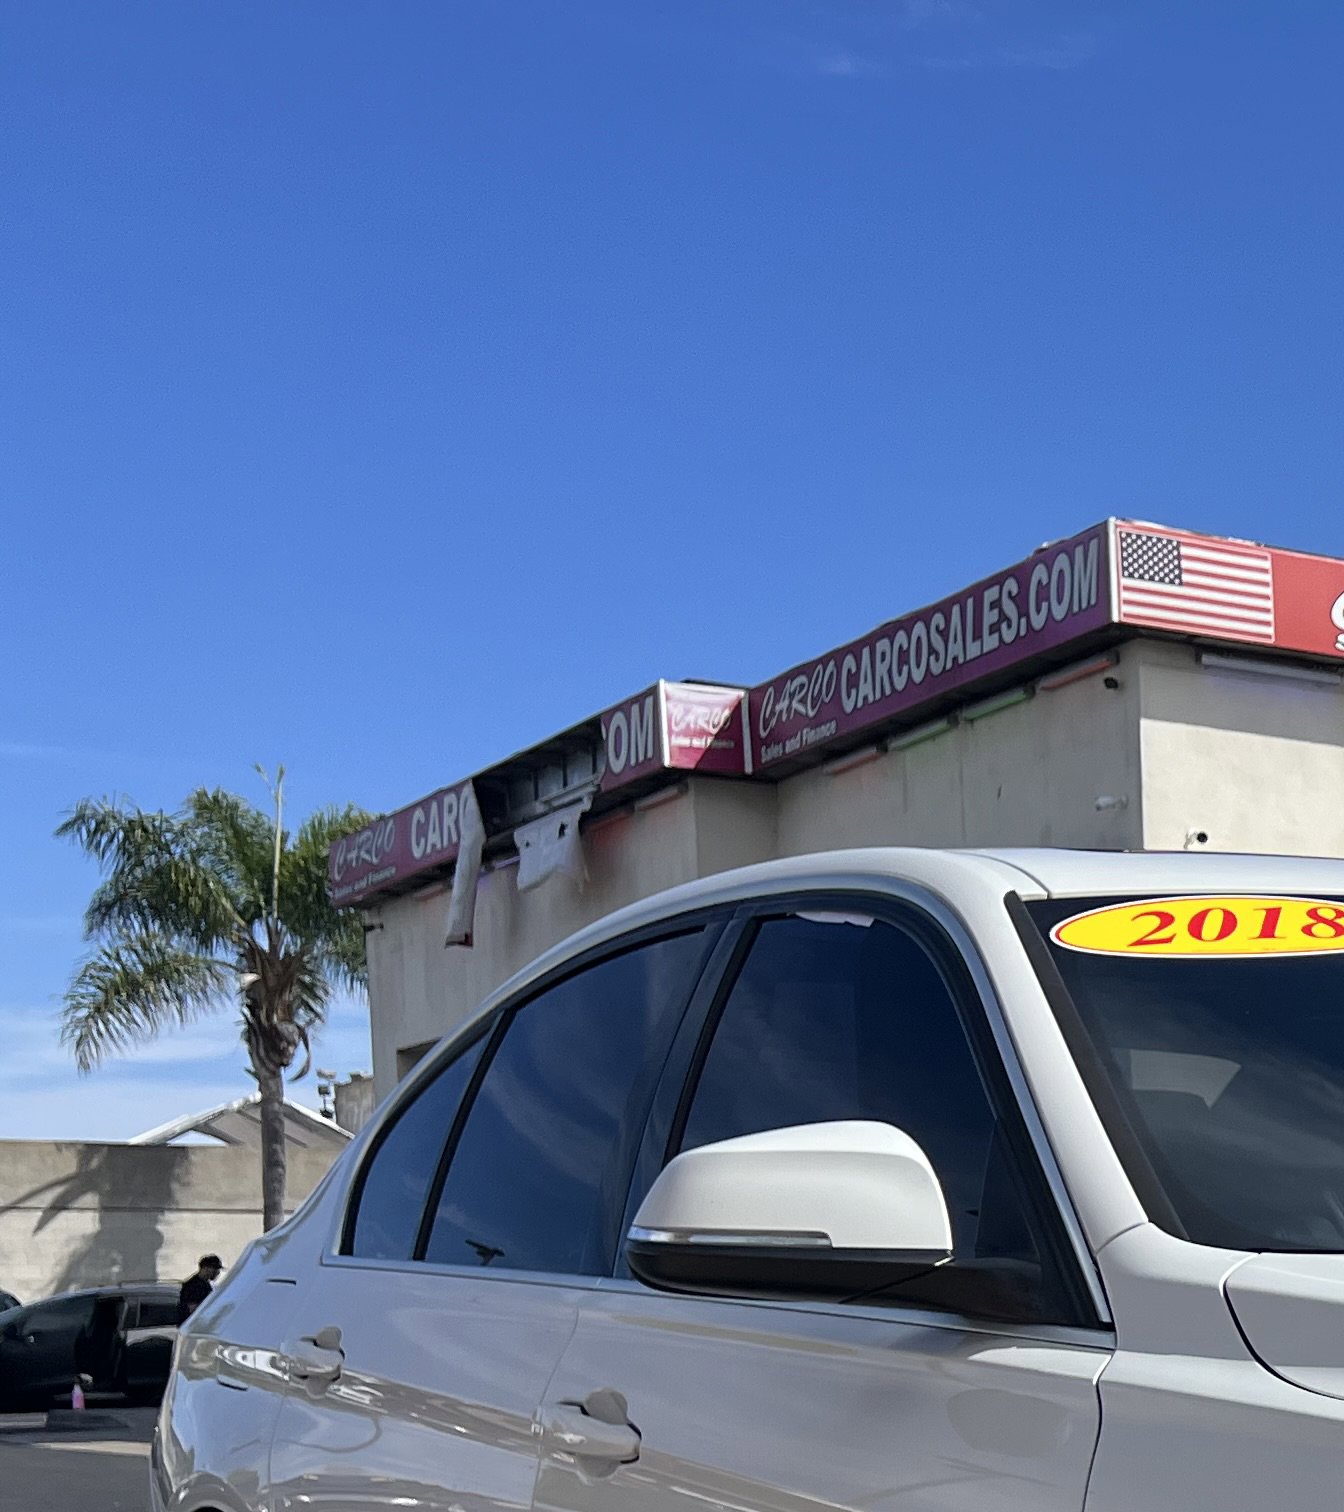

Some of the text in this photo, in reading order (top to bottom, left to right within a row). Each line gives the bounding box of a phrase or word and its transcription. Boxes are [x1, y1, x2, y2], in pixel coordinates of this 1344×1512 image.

[758, 537, 1099, 740] CARCO CARCOSALES.COM
[600, 695, 654, 784] OM
